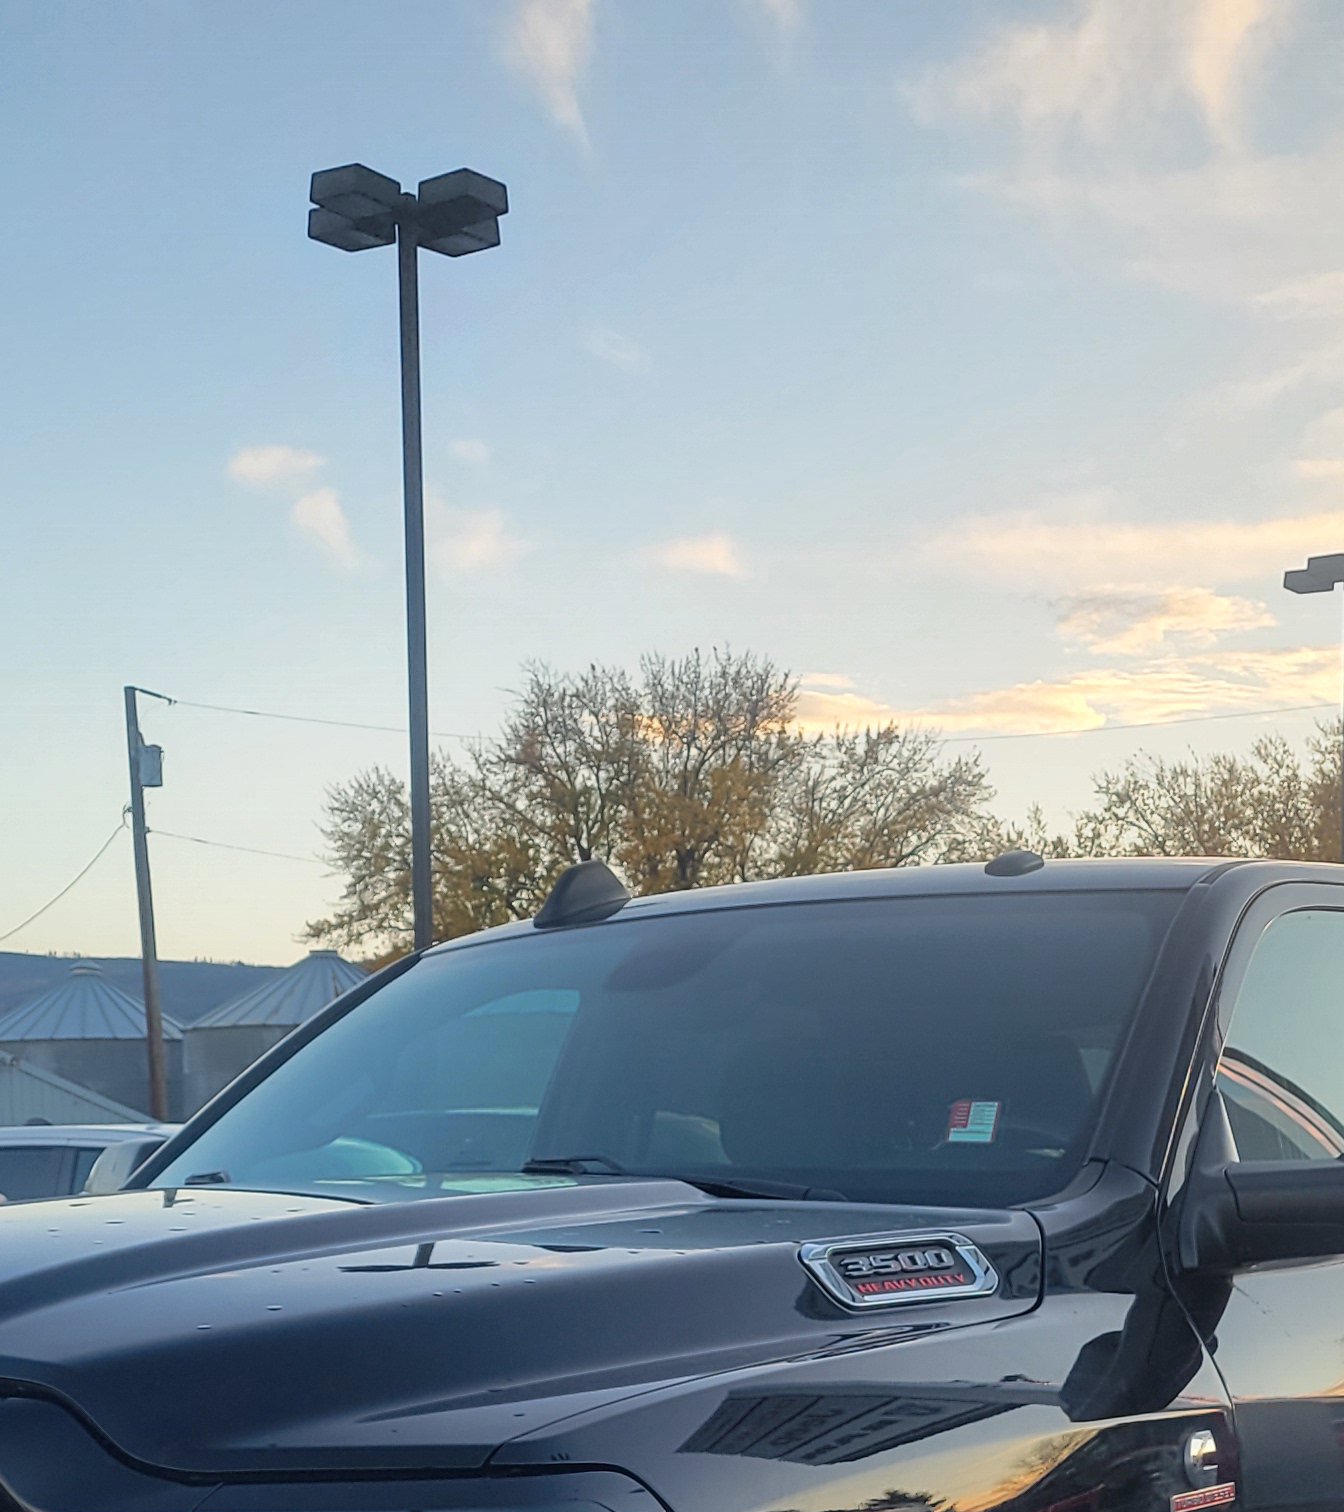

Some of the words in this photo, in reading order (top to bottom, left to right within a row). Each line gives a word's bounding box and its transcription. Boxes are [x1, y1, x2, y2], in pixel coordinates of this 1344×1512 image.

[840, 1247, 955, 1278] 3500
[856, 1278, 917, 1294] HEAVY
[918, 1273, 966, 1287] DUTY
